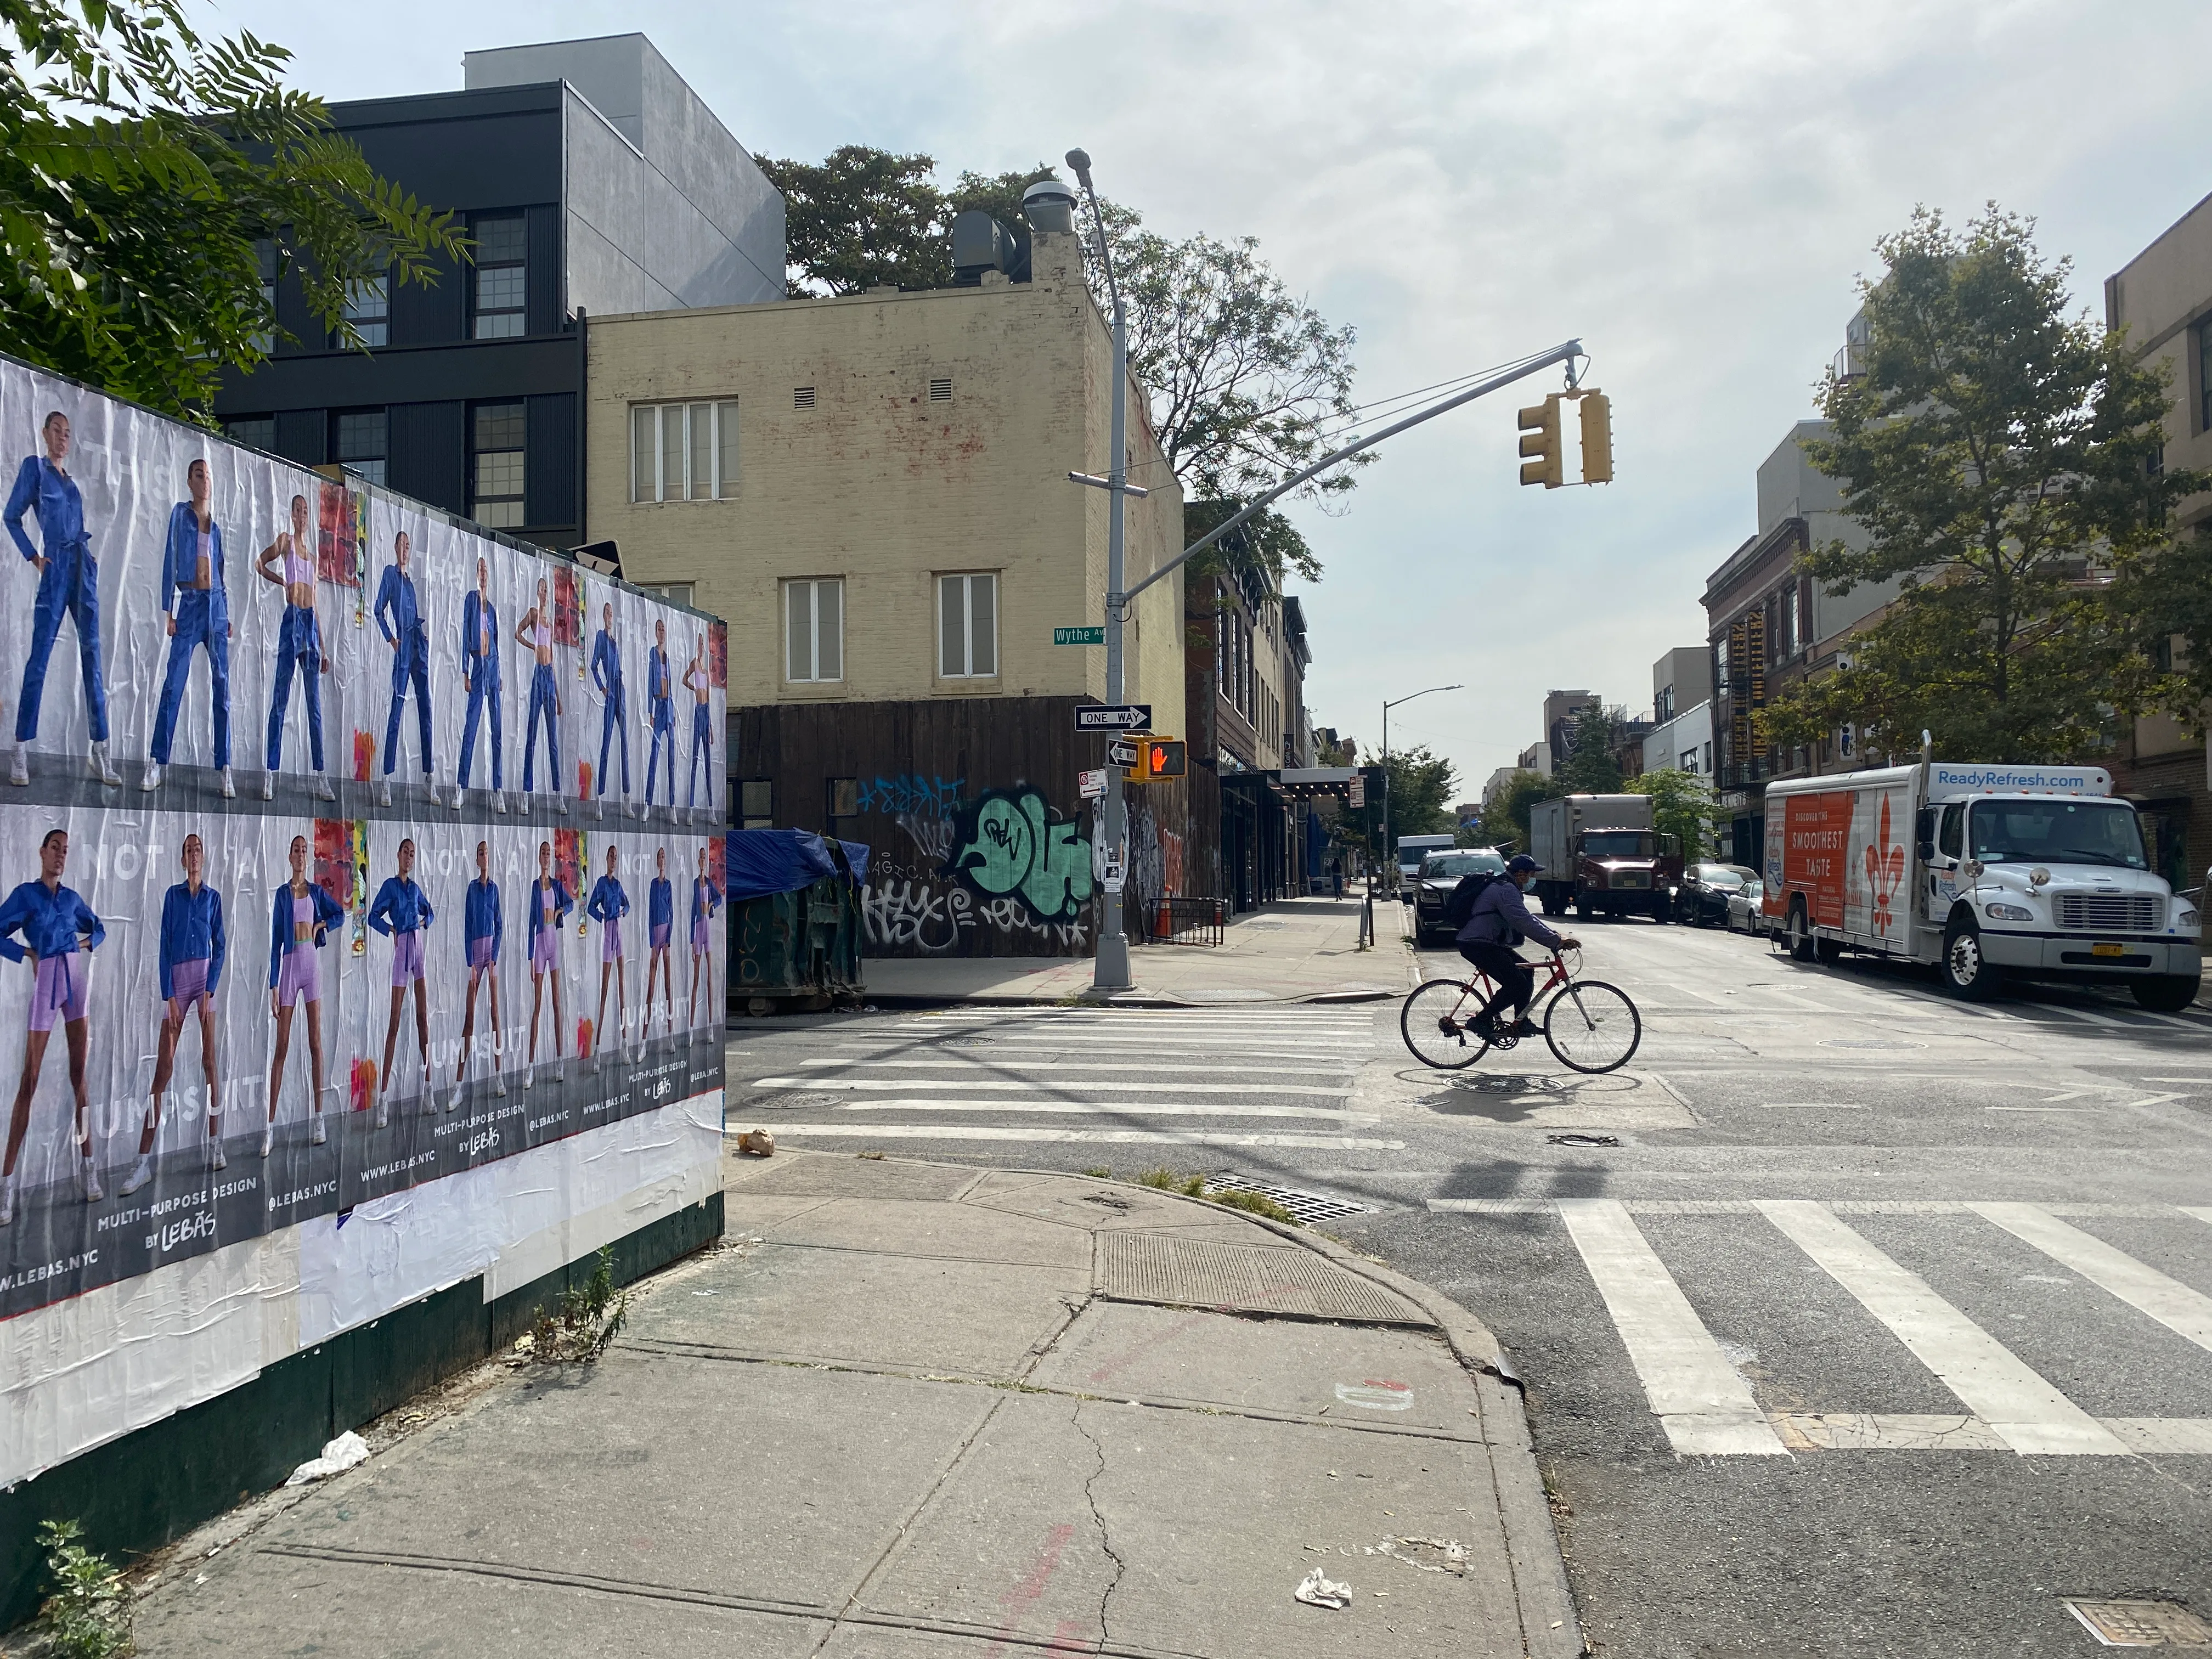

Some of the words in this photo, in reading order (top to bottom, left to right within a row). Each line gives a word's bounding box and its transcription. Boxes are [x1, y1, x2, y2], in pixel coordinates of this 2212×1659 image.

[1056, 629, 1090, 644] Wythe
[1087, 713, 1108, 723] ONE
[1118, 713, 1140, 723] WAY
[1114, 748, 1122, 758] ONE
[1126, 751, 1136, 760] WAY
[1939, 771, 2084, 787] ReadyRefresh.com
[1796, 812, 1818, 822] DISCOVER
[1818, 811, 1827, 821] THE
[1792, 830, 1843, 849] SMOOTHEST
[82, 844, 164, 880] NOT
[238, 847, 257, 879] A
[421, 849, 467, 876] NOT
[506, 850, 519, 876] A
[622, 853, 651, 875] NOT
[1806, 859, 1831, 877] TASTE
[620, 996, 689, 1031] JUMPSUIT
[419, 1025, 526, 1072] JUMPSUIT
[669, 1059, 687, 1071] DESIGN
[691, 1066, 718, 1083] @LEBA.NYC
[644, 1087, 651, 1097] BY
[72, 1074, 263, 1145] JUMPSUIT
[434, 1111, 494, 1137] MULTI-PURPOSE
[497, 1104, 524, 1120] DESIGN
[529, 1110, 569, 1131] @LEBAS.NYC
[459, 1141, 469, 1153] BY
[360, 1150, 435, 1182] WWW.LEBAS.NYC
[97, 1190, 207, 1231] MULTI-PURPOSE
[212, 1177, 257, 1200] DESIGN
[269, 1180, 336, 1212] @LEBAS.NYC
[145, 1232, 159, 1249] BY
